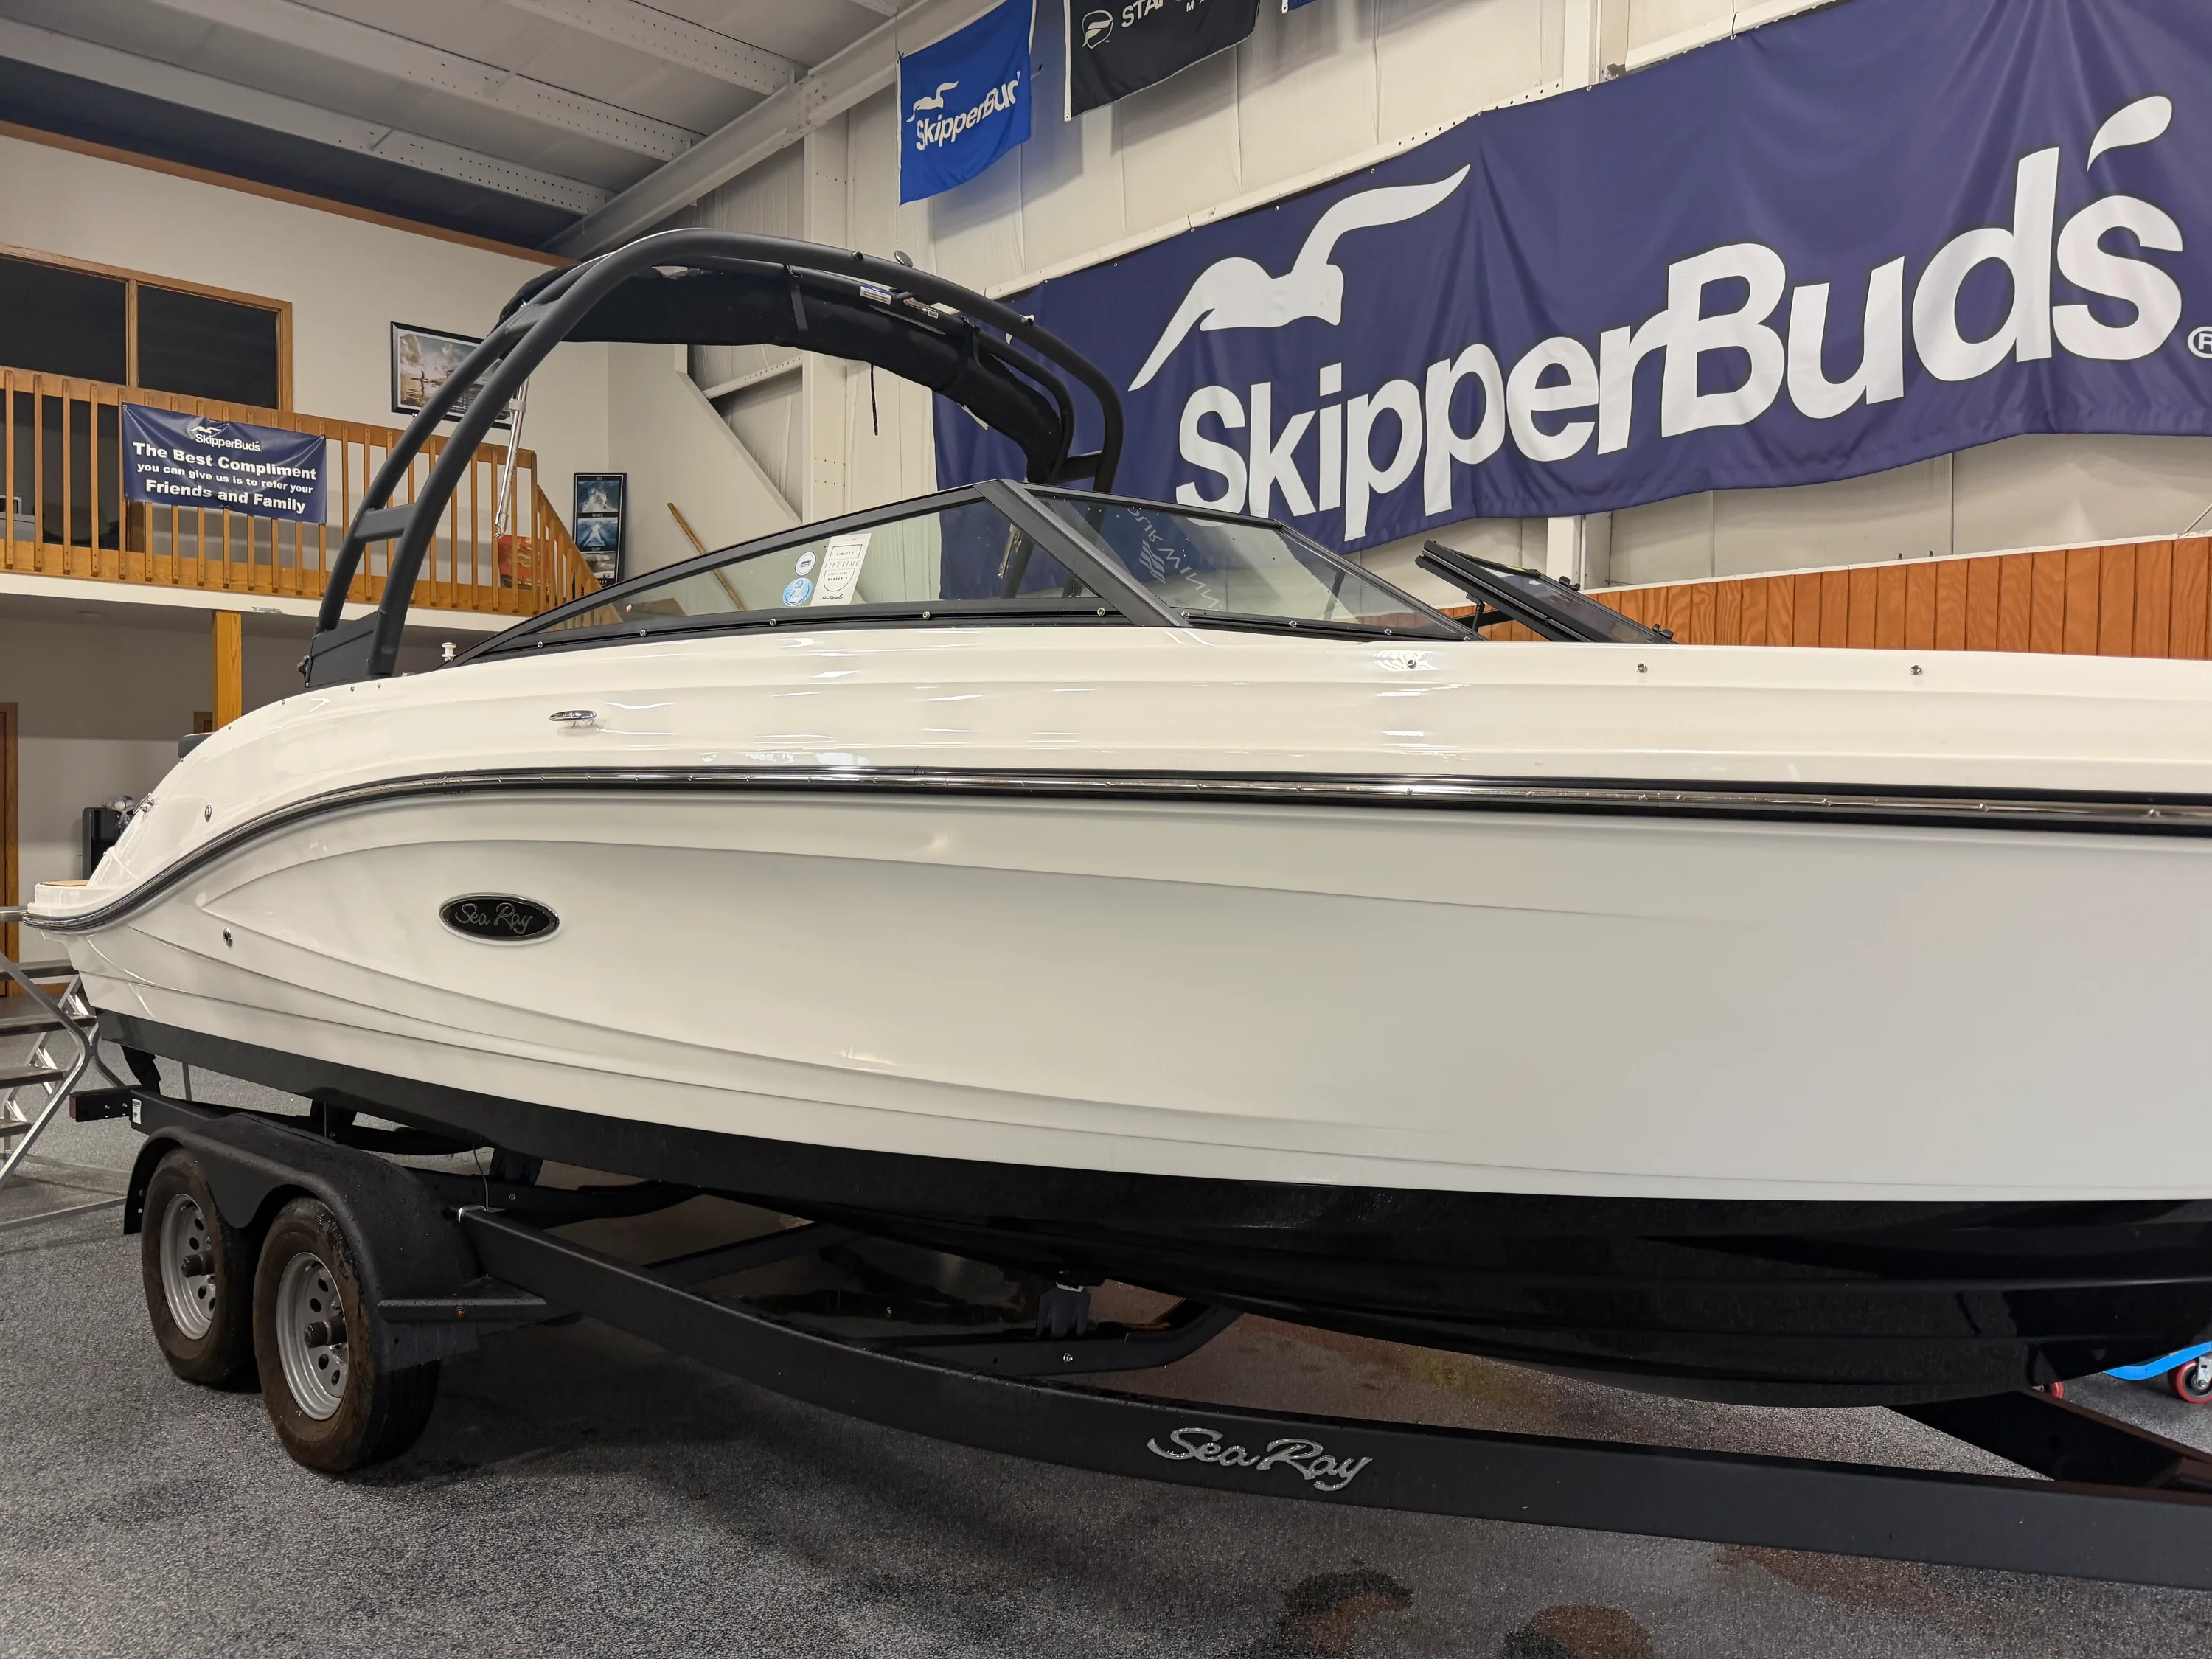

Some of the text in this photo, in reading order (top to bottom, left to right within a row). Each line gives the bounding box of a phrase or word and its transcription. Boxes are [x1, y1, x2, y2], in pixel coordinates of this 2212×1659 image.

[133, 442, 317, 480] The Best Compliment
[137, 463, 313, 494] you can give us is to refer your
[146, 479, 306, 514] Friends and Family
[824, 560, 860, 568] LIFETIME
[455, 902, 534, 935] Sea Ray
[1147, 1427, 1373, 1492] Sea Ray
